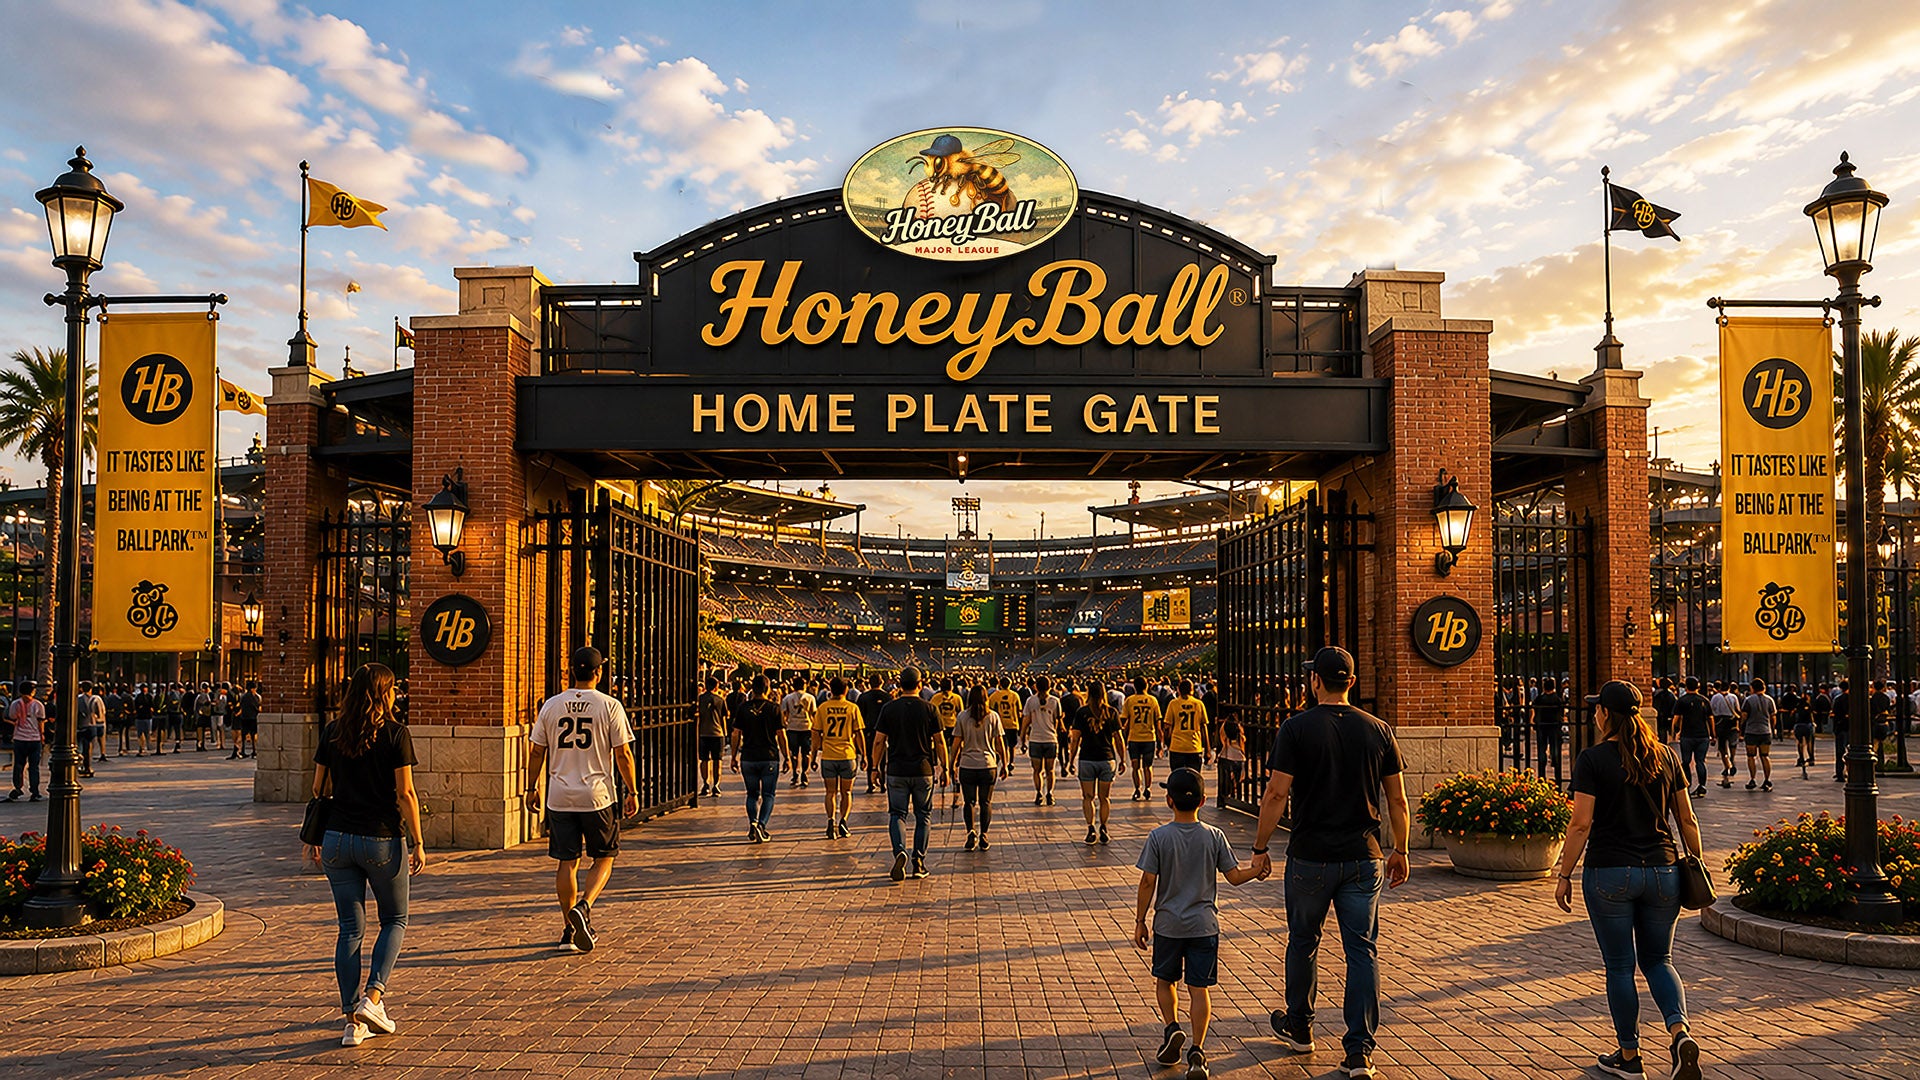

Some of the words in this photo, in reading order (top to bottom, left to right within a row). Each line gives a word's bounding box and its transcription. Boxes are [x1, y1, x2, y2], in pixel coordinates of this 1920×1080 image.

[914, 246, 952, 254] MAJOR
[957, 246, 1000, 254] LEAGUE
[131, 363, 184, 413] HB
[1752, 368, 1803, 417] HB
[692, 393, 855, 434] HOME
[888, 393, 1053, 434] PLATE
[1083, 393, 1221, 434] GATE
[107, 450, 120, 473] IT
[123, 450, 173, 473] TASTES
[177, 450, 205, 473] LIKE
[1731, 454, 1744, 476] IT
[1746, 454, 1795, 477] TASTES
[1799, 455, 1827, 477] LIKE
[108, 489, 150, 511] BEING
[153, 489, 174, 512] AT
[175, 489, 202, 512] THE
[1735, 493, 1775, 515] BEING
[1778, 493, 1796, 515] AT
[1798, 493, 1824, 515] THE
[435, 610, 476, 651] HB
[1427, 611, 1468, 651] HB
[827, 716, 847, 738] 27
[1179, 711, 1195, 730] 21
[557, 716, 593, 750] 25
